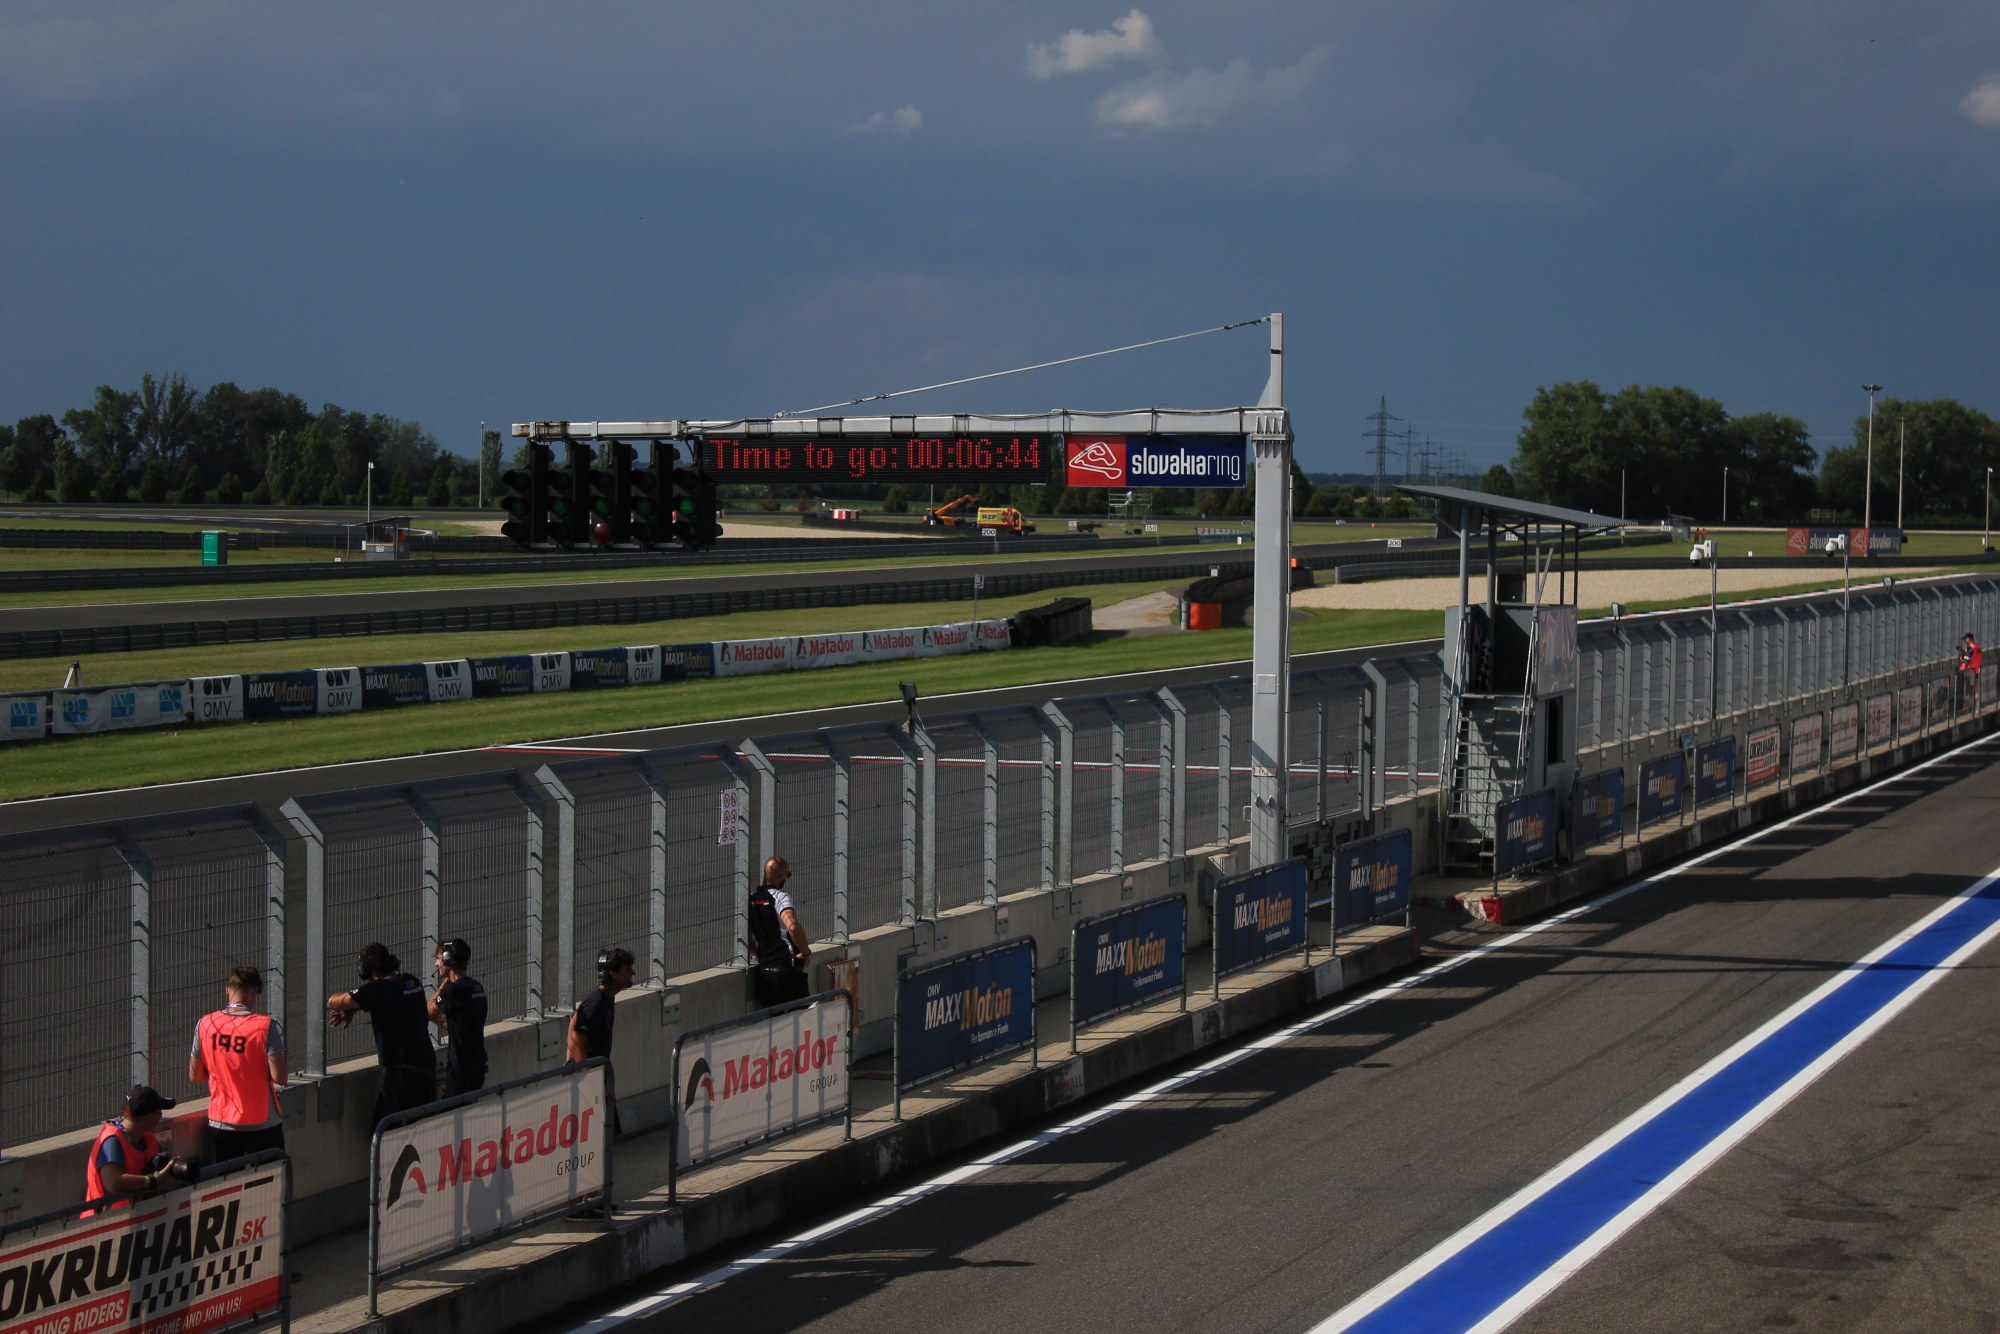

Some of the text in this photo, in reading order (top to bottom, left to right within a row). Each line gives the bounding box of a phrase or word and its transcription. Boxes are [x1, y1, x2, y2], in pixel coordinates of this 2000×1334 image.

[710, 438, 1041, 478] Time to go: 00:06:44
[1131, 447, 1240, 481] slovakiaring
[810, 637, 854, 657] Matador
[873, 631, 914, 650] Matador
[933, 628, 968, 646] Matador
[734, 642, 786, 663] Matador
[366, 674, 389, 690] MAXX
[475, 666, 497, 681] MAXX
[541, 674, 563, 689] OMV
[635, 667, 655, 681] OMV
[248, 680, 315, 704] MAXX Motion
[328, 691, 353, 708] OMV
[438, 683, 462, 698] OMV
[203, 700, 232, 717] OMV
[1506, 817, 1524, 841] MAXX
[1349, 858, 1398, 894] MAXX Motion
[1233, 891, 1292, 932] MAXX Motion
[1095, 930, 1166, 977] MAXX Motion
[927, 983, 941, 998] OMV
[925, 981, 1012, 1031] MAXX Motion
[212, 1033, 247, 1054] 198
[971, 1022, 1009, 1045] Performance Fuels
[723, 1030, 837, 1100] Matador
[809, 1073, 838, 1093] GROUP
[437, 1104, 594, 1192] Matador
[556, 1151, 595, 1176] GROUP
[73, 1299, 125, 1333] RIDERS
[181, 1311, 203, 1331] AND
[203, 1303, 225, 1323] JOIN
[225, 1296, 242, 1314] US!
